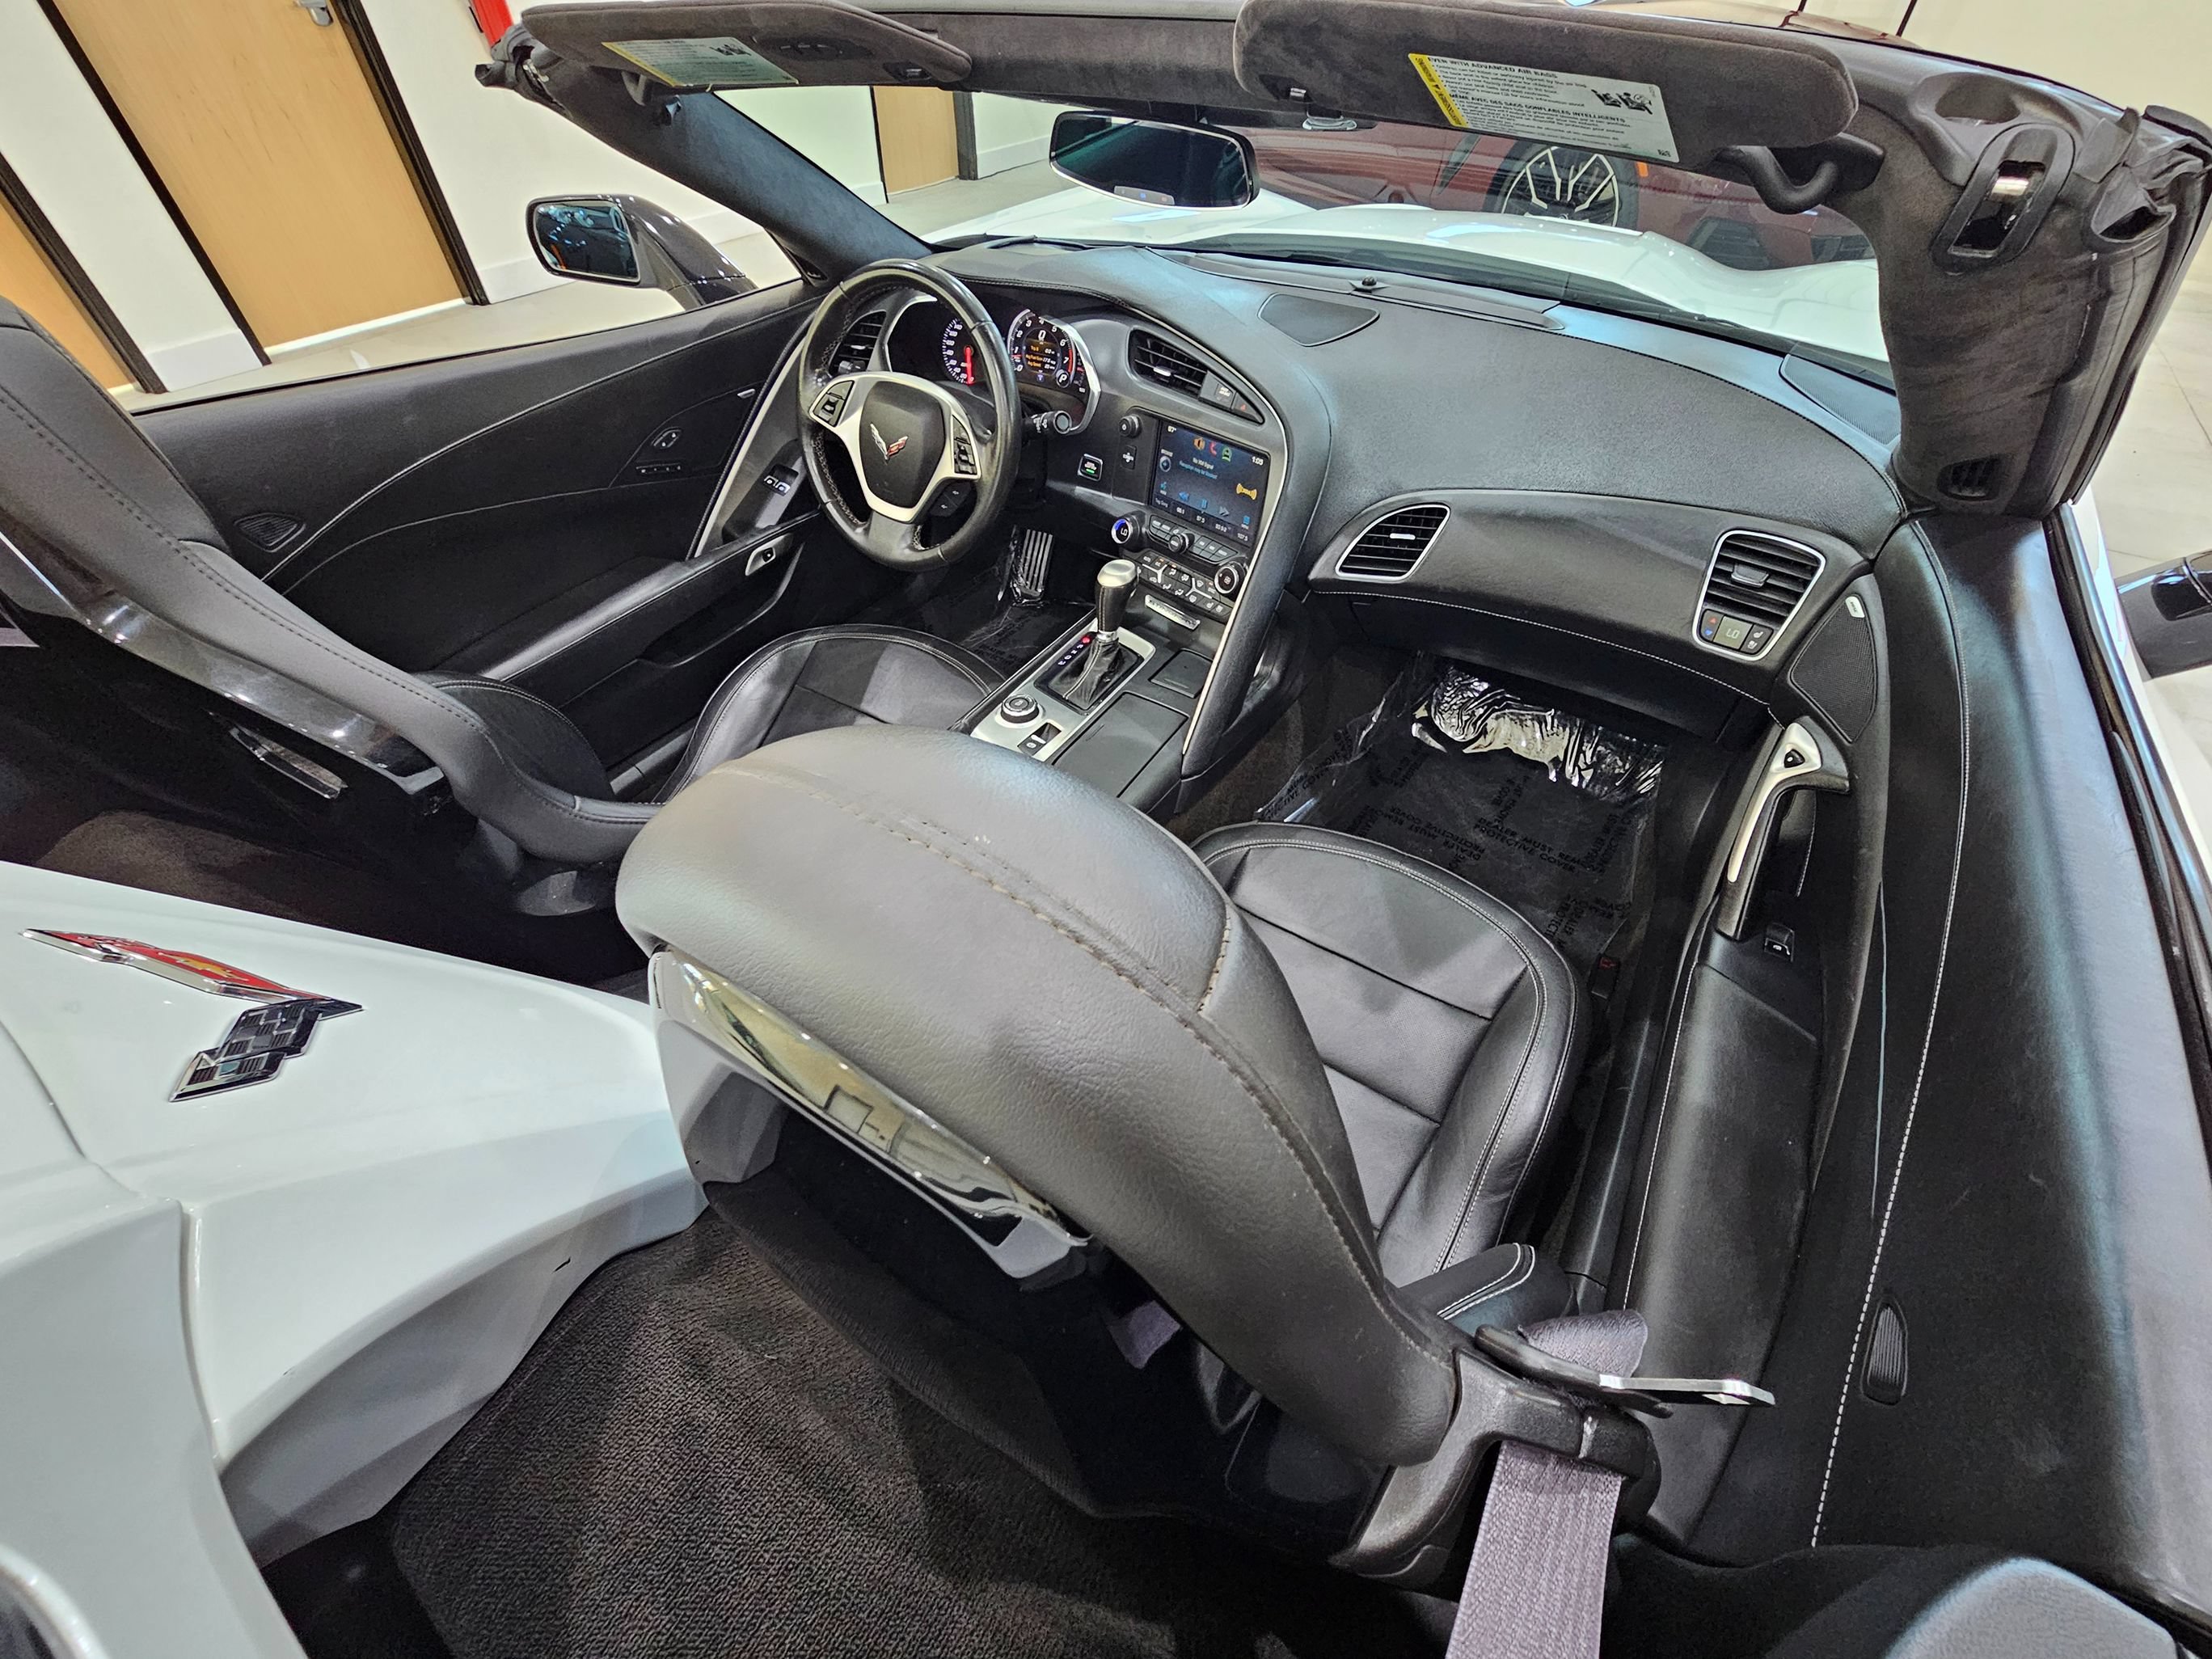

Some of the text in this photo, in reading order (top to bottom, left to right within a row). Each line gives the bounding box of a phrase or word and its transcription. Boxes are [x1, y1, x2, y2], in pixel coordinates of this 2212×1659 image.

[1426, 56, 1448, 64] EVEN
[1470, 61, 1516, 73] ADVANCED
[1532, 70, 1558, 78] BAGS
[1571, 110, 1626, 124] INTELLIGENTS
[1016, 330, 1023, 338] 2
[1060, 339, 1066, 347] 6
[1059, 374, 1067, 383] P
[1391, 806, 1422, 825] COVER
[1408, 824, 1438, 840] MUST
[1476, 817, 1518, 837] DEALER
[1521, 834, 1554, 854] MUST
[1443, 839, 1482, 861] DEALER
[1473, 823, 1577, 873] PROTECTIVE COVER
